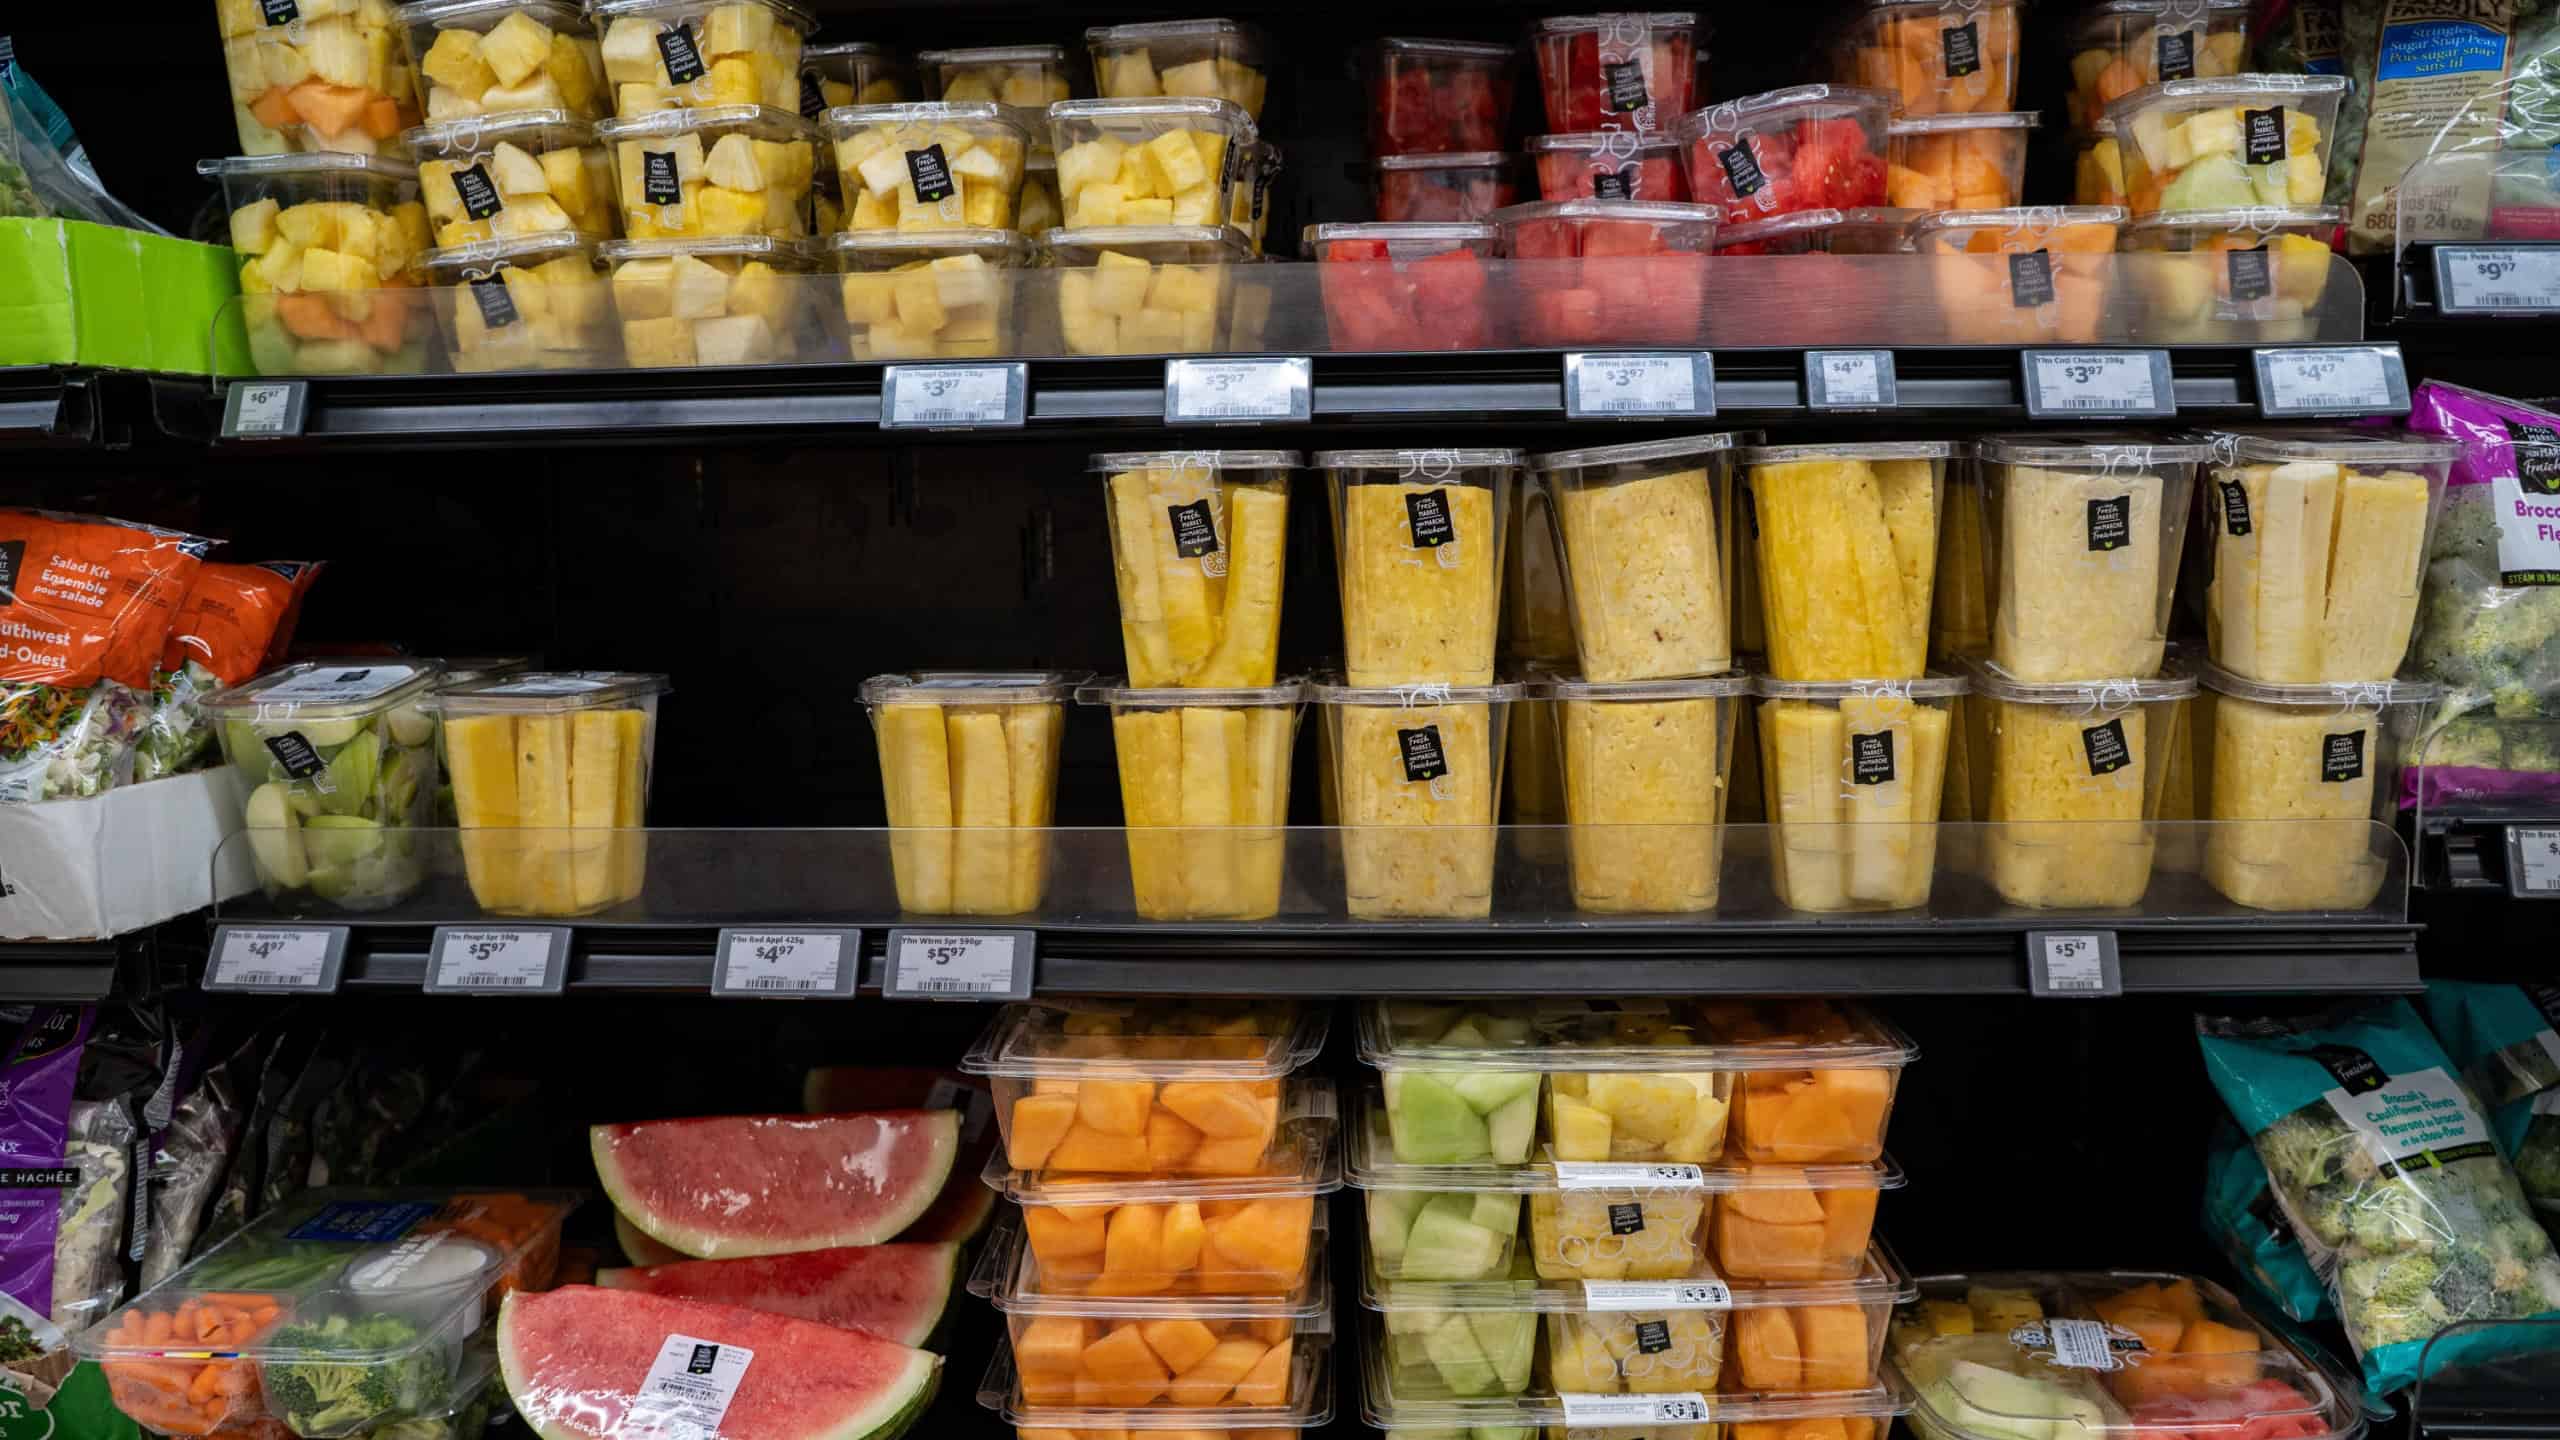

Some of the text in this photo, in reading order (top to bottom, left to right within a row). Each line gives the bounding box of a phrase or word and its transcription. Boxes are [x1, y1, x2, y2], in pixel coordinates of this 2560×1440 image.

[2390, 33, 2497, 53] Sugar Snap Peas
[2421, 48, 2458, 62] sugar
[2463, 47, 2497, 58] snap
[2254, 118, 2275, 128] Fresh
[2255, 125, 2275, 133] MARKET
[2365, 213, 2397, 230] 680
[2424, 213, 2447, 230] 24
[2451, 217, 2473, 231] oz
[1416, 501, 1438, 510] Fresh
[1418, 507, 1440, 516] MARKET
[2096, 506, 2119, 515] Fresh
[1179, 511, 1201, 522] Fresh
[50, 554, 112, 580] Salad Kit
[41, 569, 108, 595] Ensemble
[33, 585, 58, 598] pour
[61, 590, 104, 608] salade
[0, 622, 71, 646] uthwest
[0, 643, 67, 669] d-Ouest
[1408, 735, 1430, 746] Fresh
[1410, 742, 1432, 752] MARKET
[1860, 740, 1883, 750] Fresh
[2366, 1098, 2457, 1123] Cauliflower Florets
[1, 1170, 73, 1183] E HACHÉE
